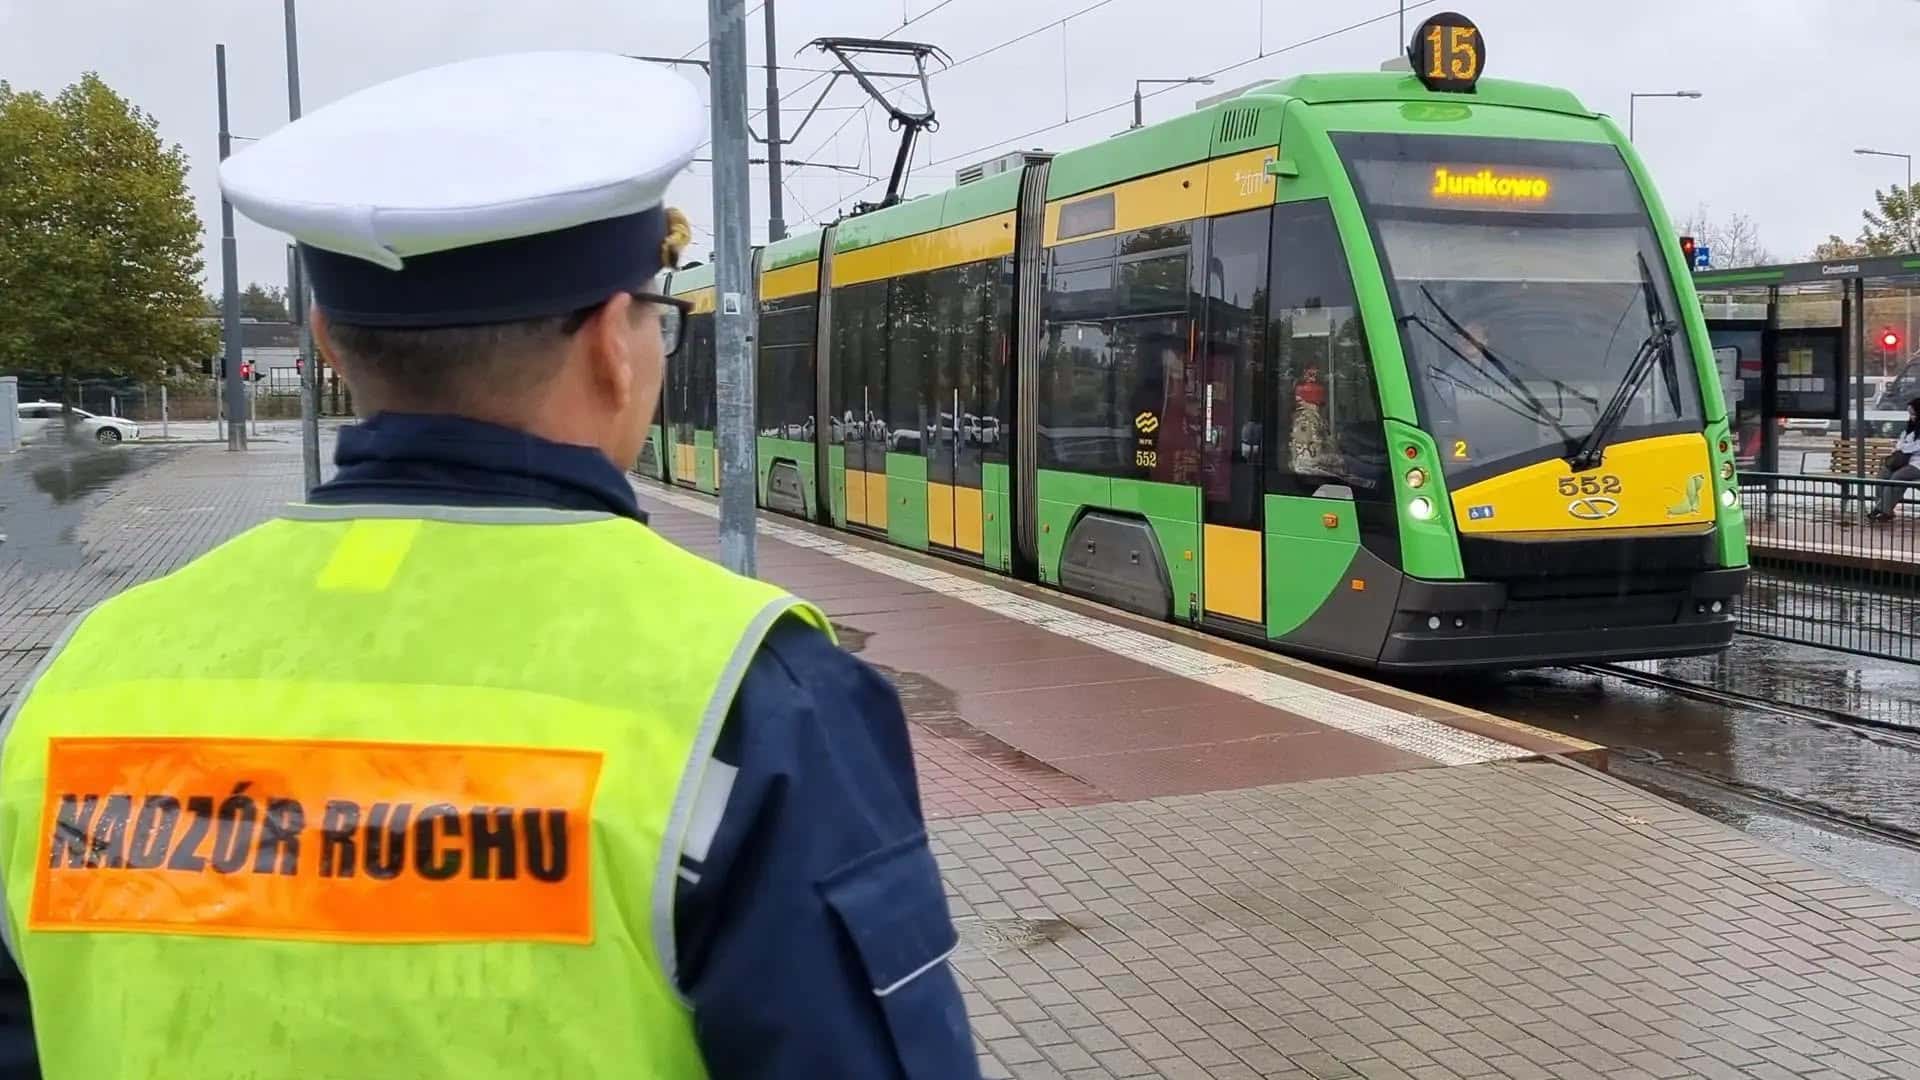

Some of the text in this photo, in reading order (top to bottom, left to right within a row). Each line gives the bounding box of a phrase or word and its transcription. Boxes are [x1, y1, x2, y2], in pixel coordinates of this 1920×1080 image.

[1427, 25, 1476, 79] 15
[1433, 169, 1548, 197] Junikowo
[1136, 450, 1157, 467] 552
[1454, 441, 1467, 457] 2
[1558, 475, 1622, 496] 552
[48, 781, 568, 882] NADZÓR RUCHU
